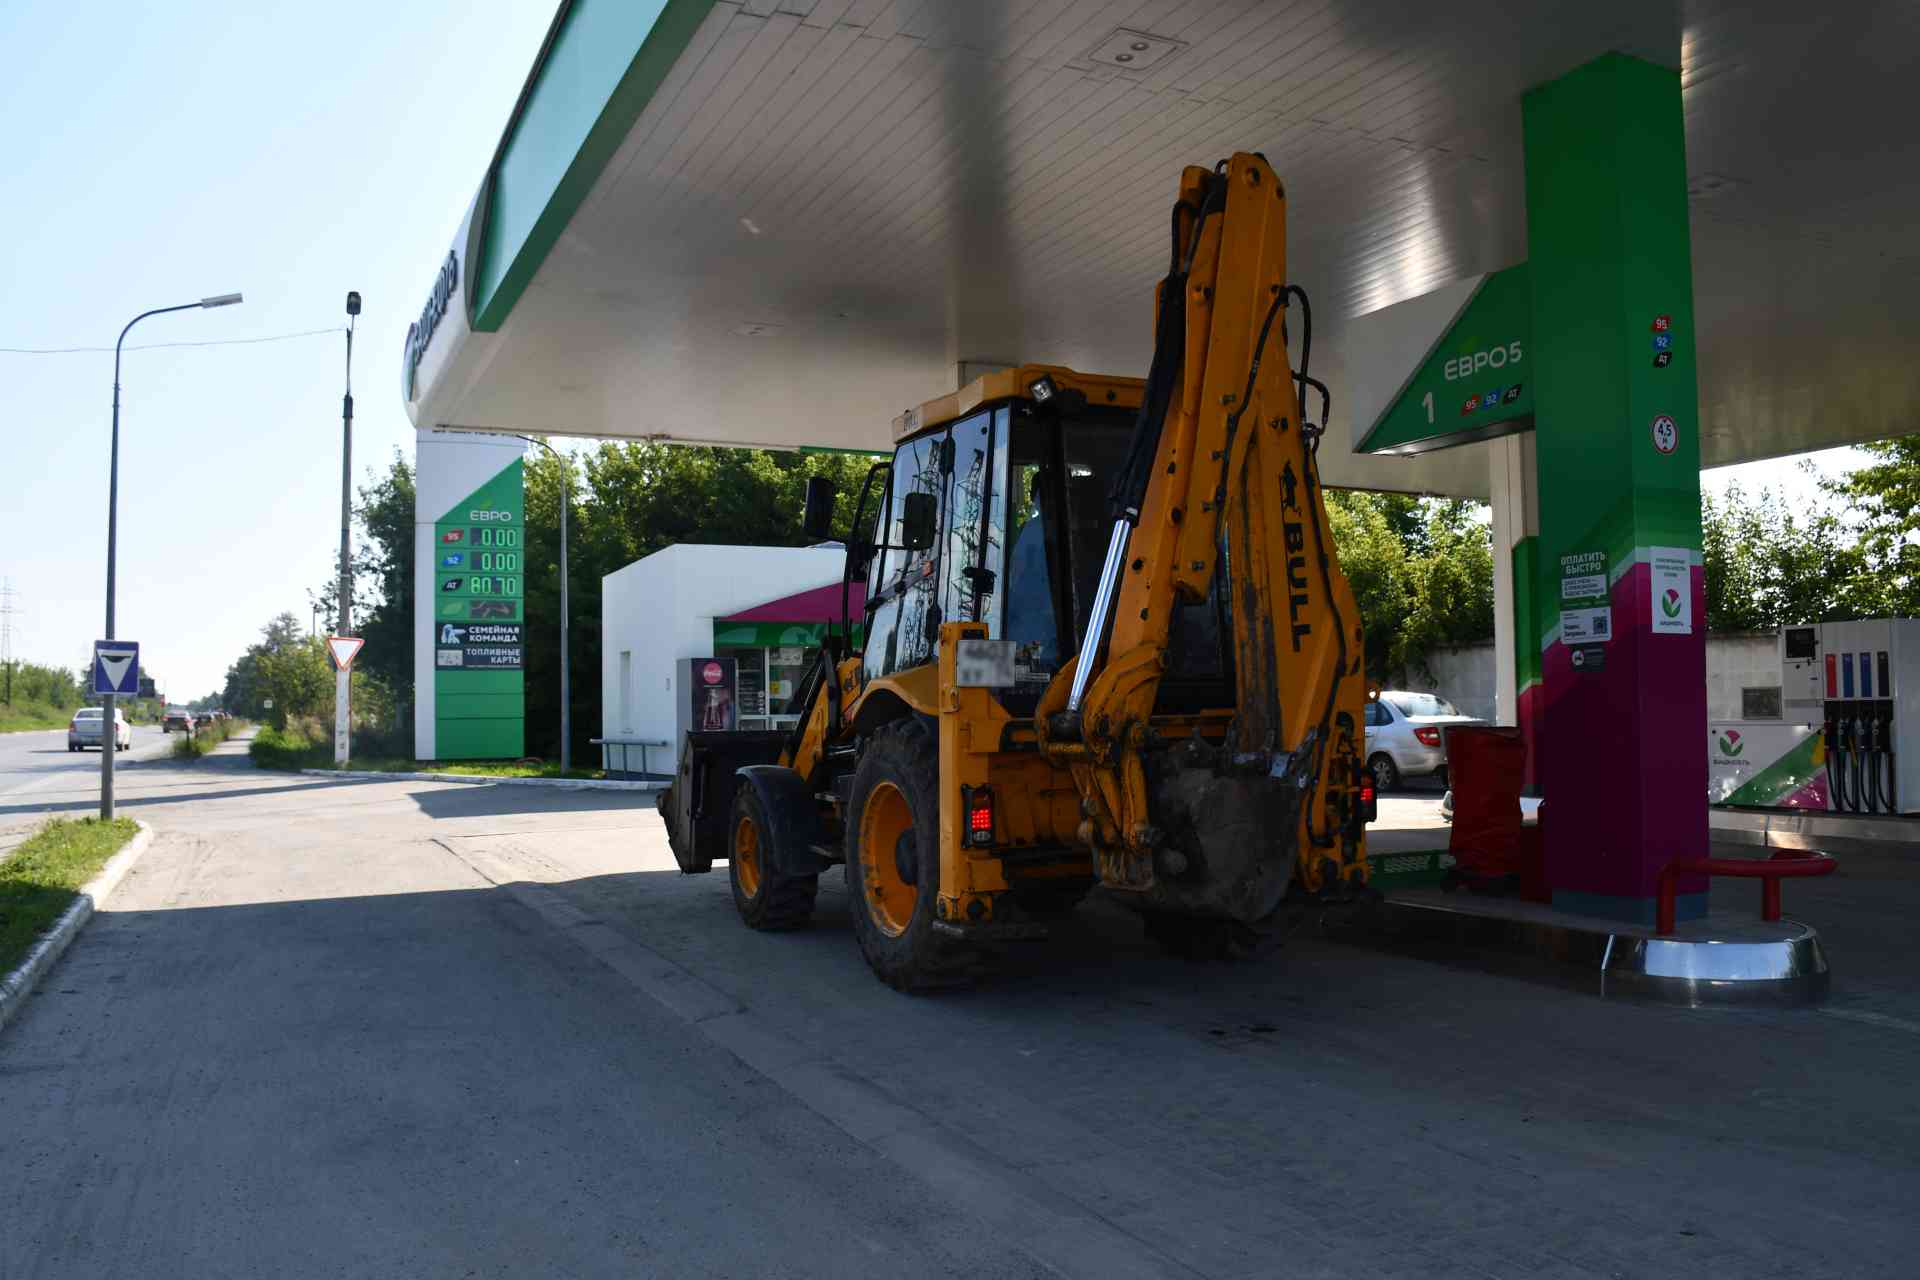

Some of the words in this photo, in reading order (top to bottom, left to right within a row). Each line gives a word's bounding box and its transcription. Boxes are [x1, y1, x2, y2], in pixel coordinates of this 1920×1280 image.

[1655, 319, 1668, 329] 95
[1656, 336, 1668, 347] 92
[1465, 399, 1477, 410] 95
[1486, 393, 1497, 405] 92
[1422, 391, 1434, 424] 1
[470, 510, 512, 521] ЕВРО
[1560, 551, 1606, 566] ОПЛАТИТЬ
[1565, 561, 1602, 575] БЫСТРО
[1285, 523, 1312, 652] BULL
[468, 623, 520, 634] СЕМЕЙНАЯ
[468, 634, 518, 643] КОМАНДА
[466, 648, 520, 656] ТОПЛИВНЫЕ
[490, 656, 520, 664] КАРТЫ
